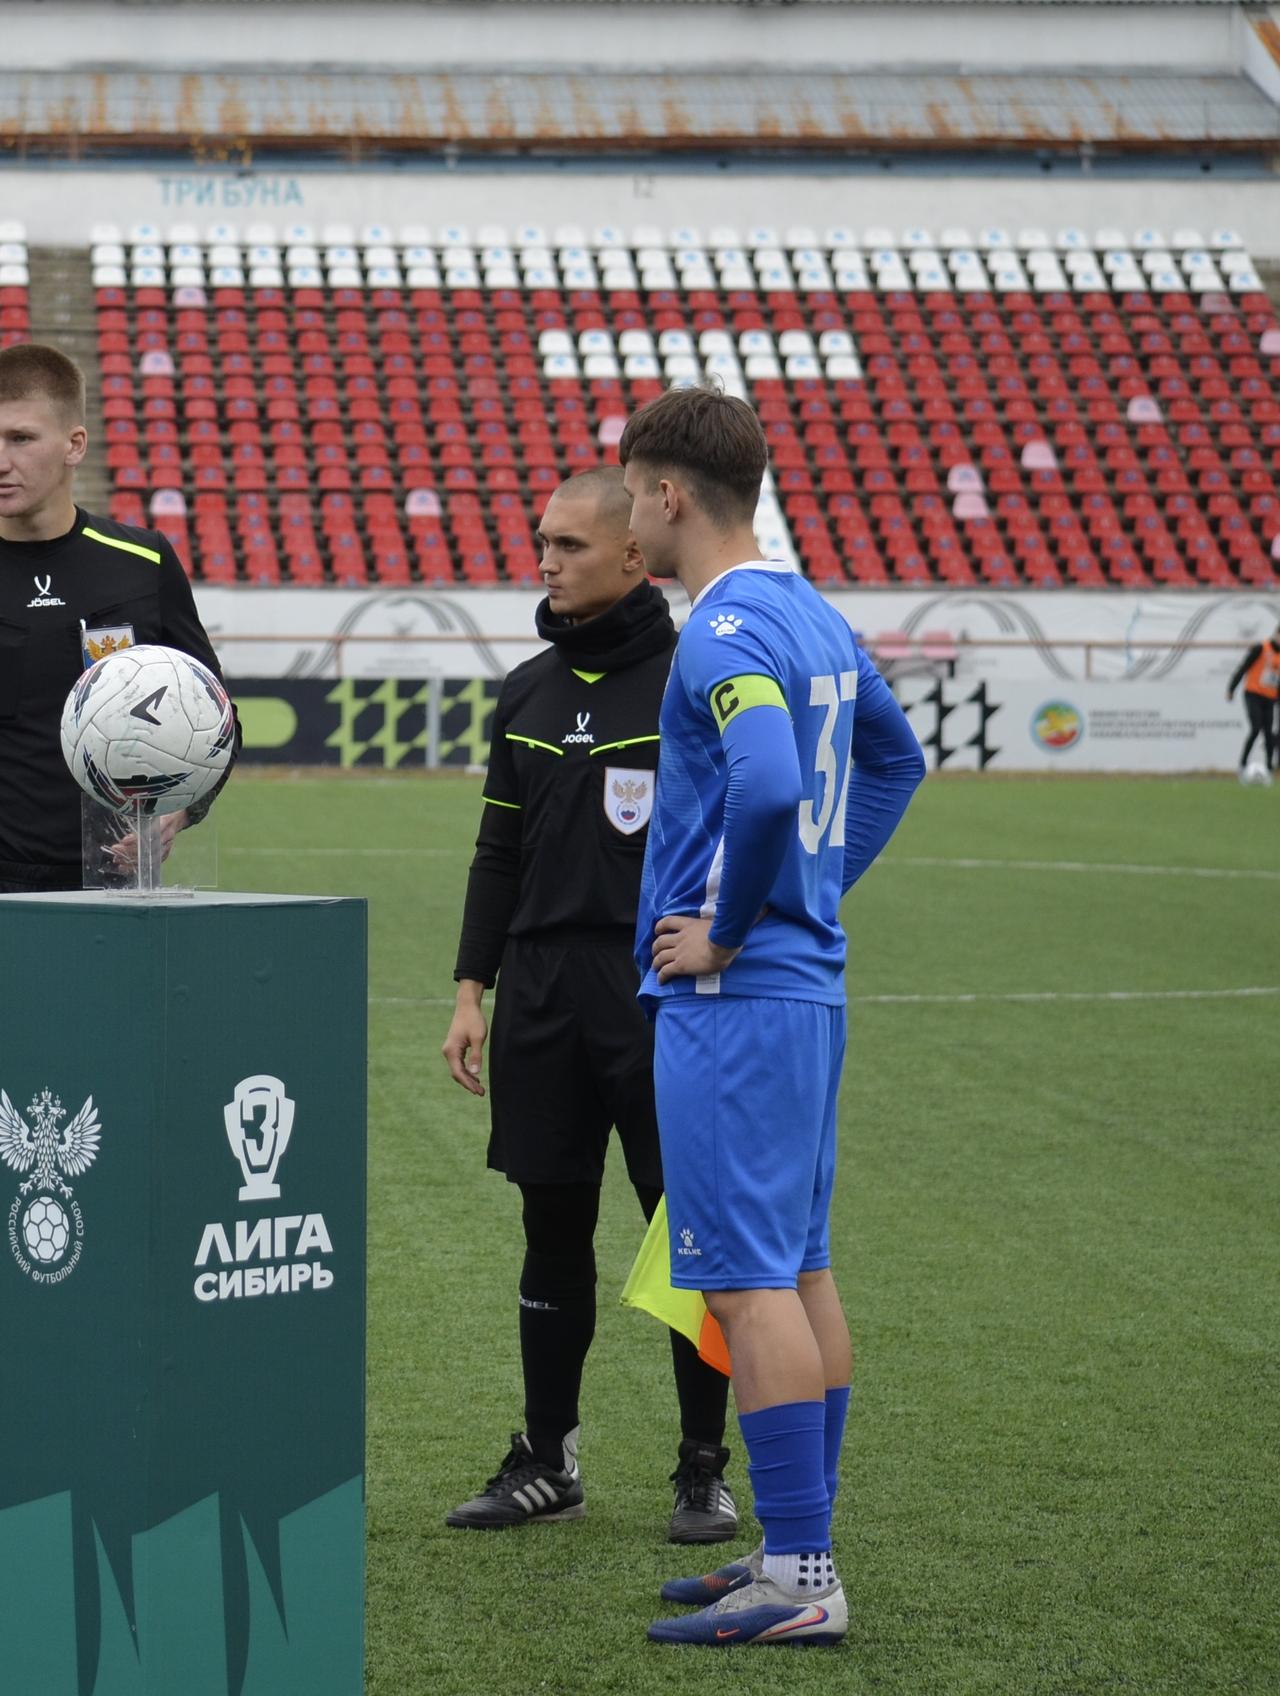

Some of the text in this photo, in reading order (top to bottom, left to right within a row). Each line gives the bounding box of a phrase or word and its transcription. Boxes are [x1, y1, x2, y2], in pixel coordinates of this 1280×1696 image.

[714, 682, 740, 721] C
[8, 1196, 84, 1284] РОССИЙСКИЙ ФУТБОЛЬНЫЙ СОЮЗ
[194, 1213, 333, 1266] ЛИГА
[193, 1262, 334, 1301] СИБИРЬ
